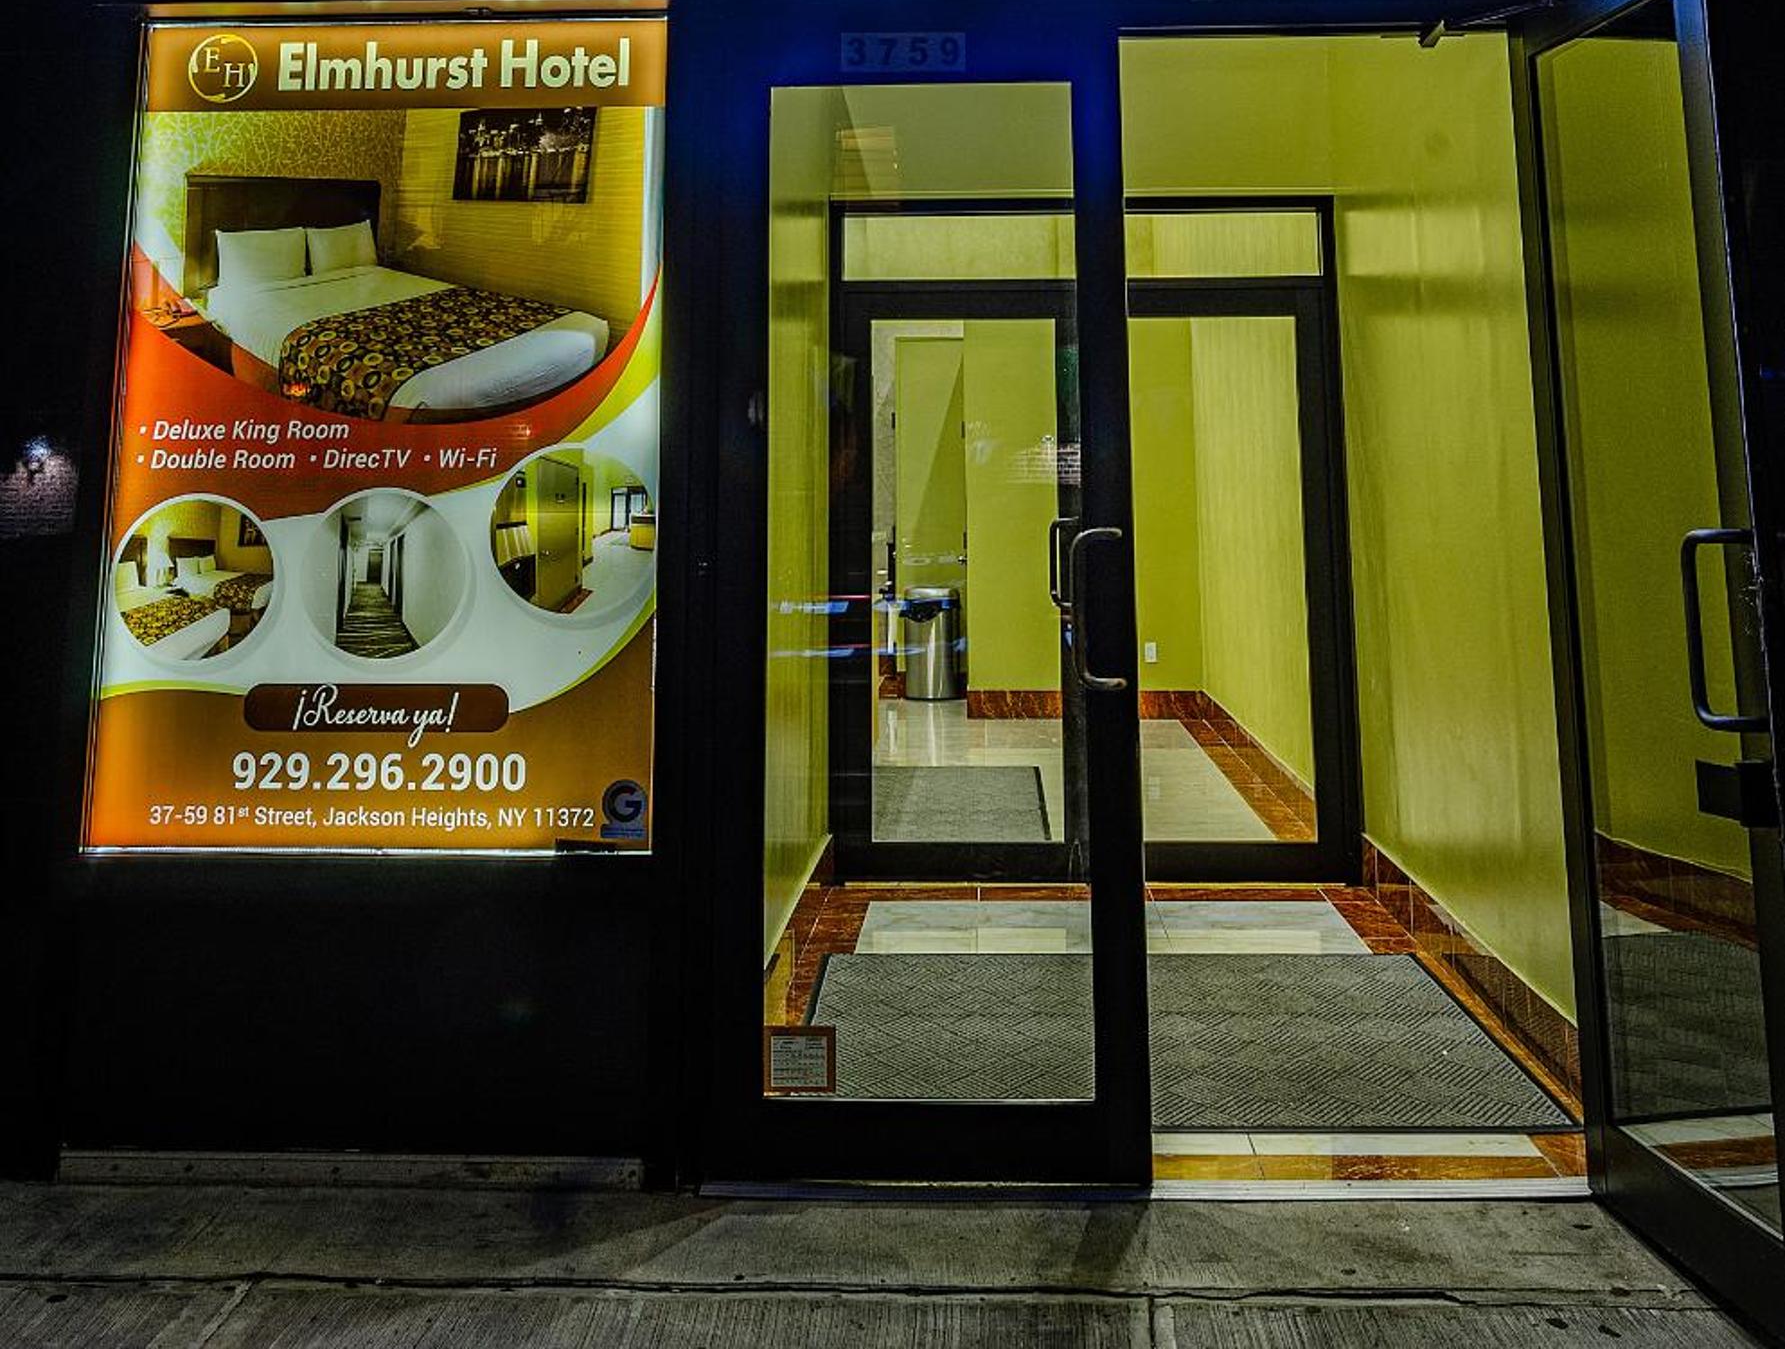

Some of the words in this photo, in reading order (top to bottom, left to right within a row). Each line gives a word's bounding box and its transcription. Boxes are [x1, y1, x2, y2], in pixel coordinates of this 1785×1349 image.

[278, 41, 488, 91] Elmhurst
[500, 37, 630, 88] Hotel
[846, 37, 959, 66] 3759
[153, 419, 226, 440] Deluxe
[232, 419, 280, 445] King
[287, 421, 349, 440] Room
[151, 449, 226, 469] Double
[233, 450, 295, 469] Room
[323, 448, 412, 469] DirecTV
[439, 447, 497, 469] Wi-Fi
[407, 691, 460, 748] ya!
[232, 752, 526, 792] 929.296.2900
[149, 805, 208, 825] 37-59
[213, 805, 249, 825] 81st
[254, 806, 317, 828] Street,
[322, 806, 405, 827] Jackson
[411, 806, 493, 831] Heights,
[498, 808, 527, 827] NY
[533, 808, 594, 827] 11372
